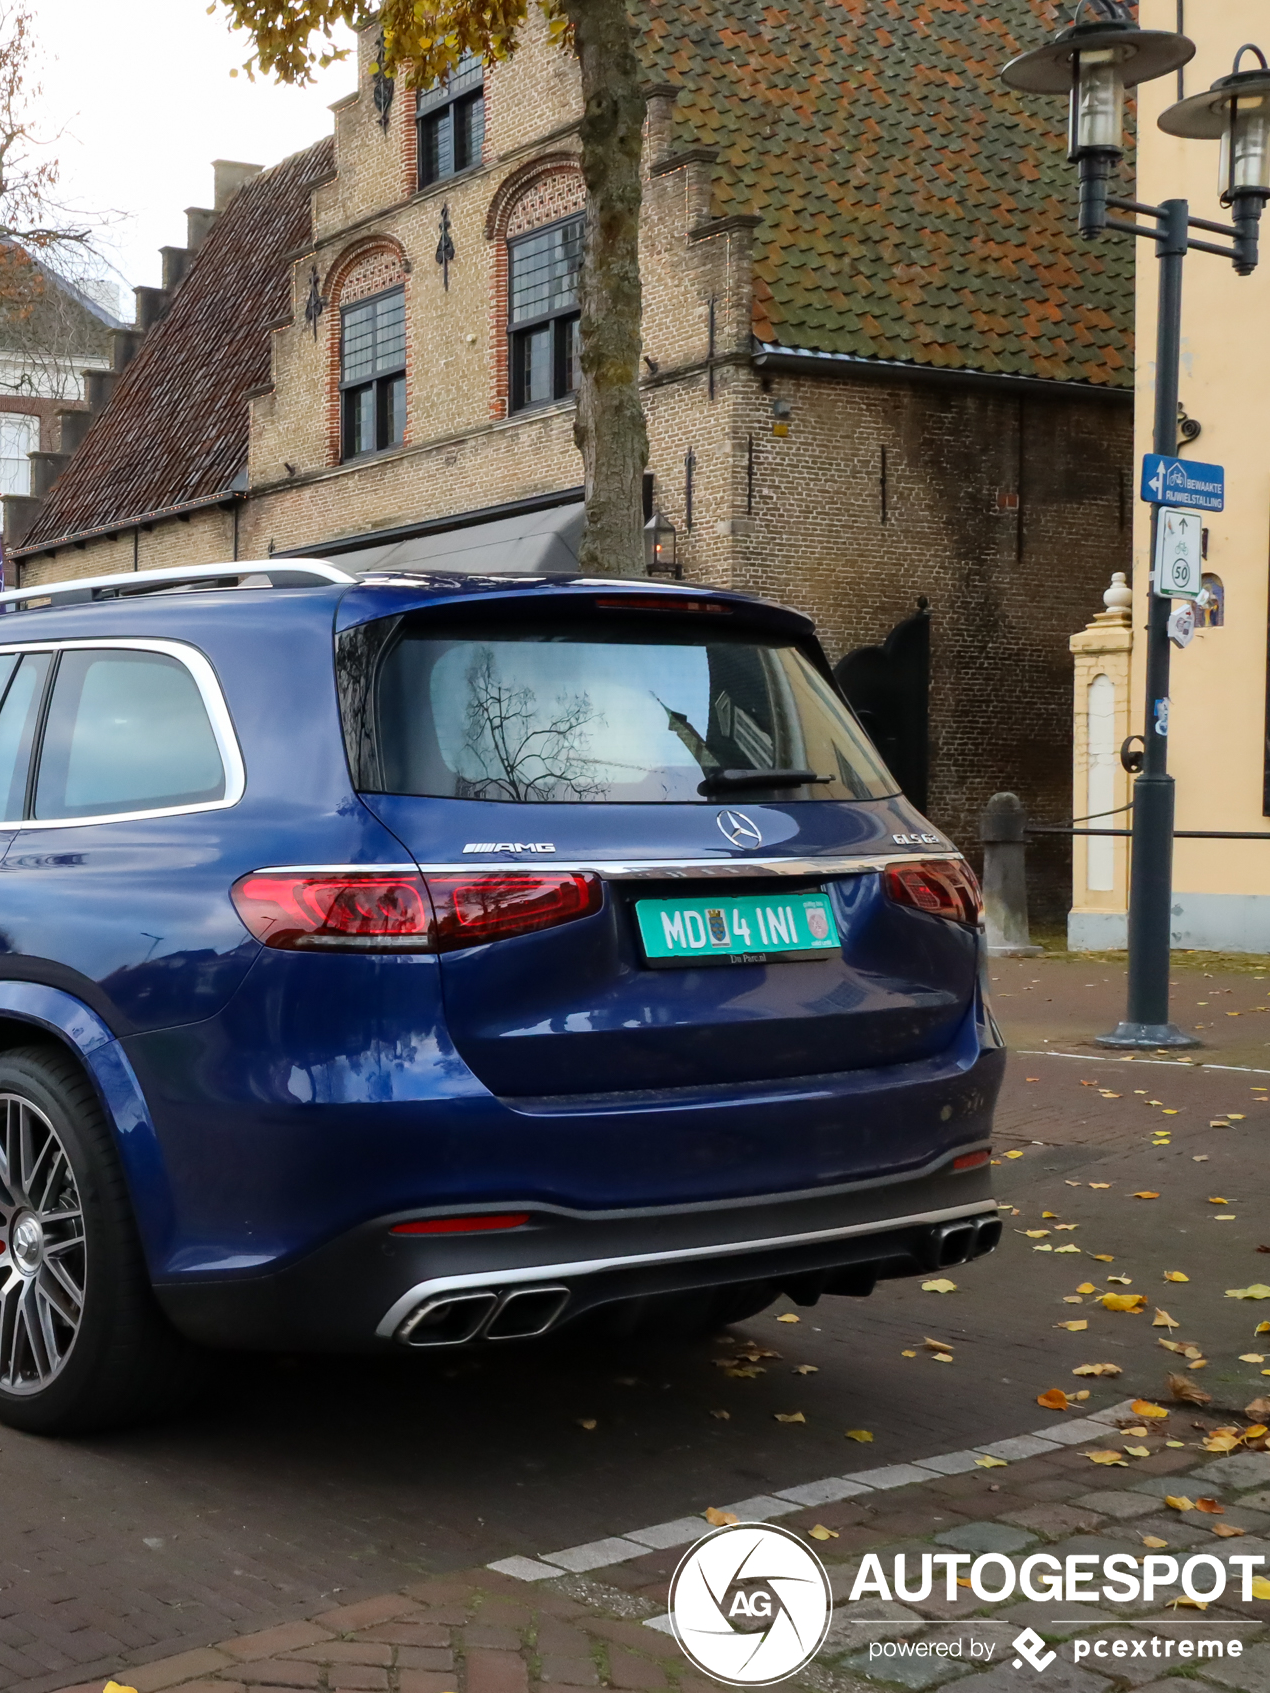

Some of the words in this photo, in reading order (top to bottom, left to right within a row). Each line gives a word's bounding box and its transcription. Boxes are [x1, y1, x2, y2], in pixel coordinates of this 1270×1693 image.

[1186, 479, 1223, 494] BEWAAKTE
[1165, 490, 1223, 508] RIJWIELSTALLING
[1174, 566, 1188, 580] 50
[892, 834, 923, 845] GLS
[494, 843, 557, 853] AMG
[660, 910, 707, 950] MD
[732, 908, 751, 946] 4
[755, 906, 798, 945] INI
